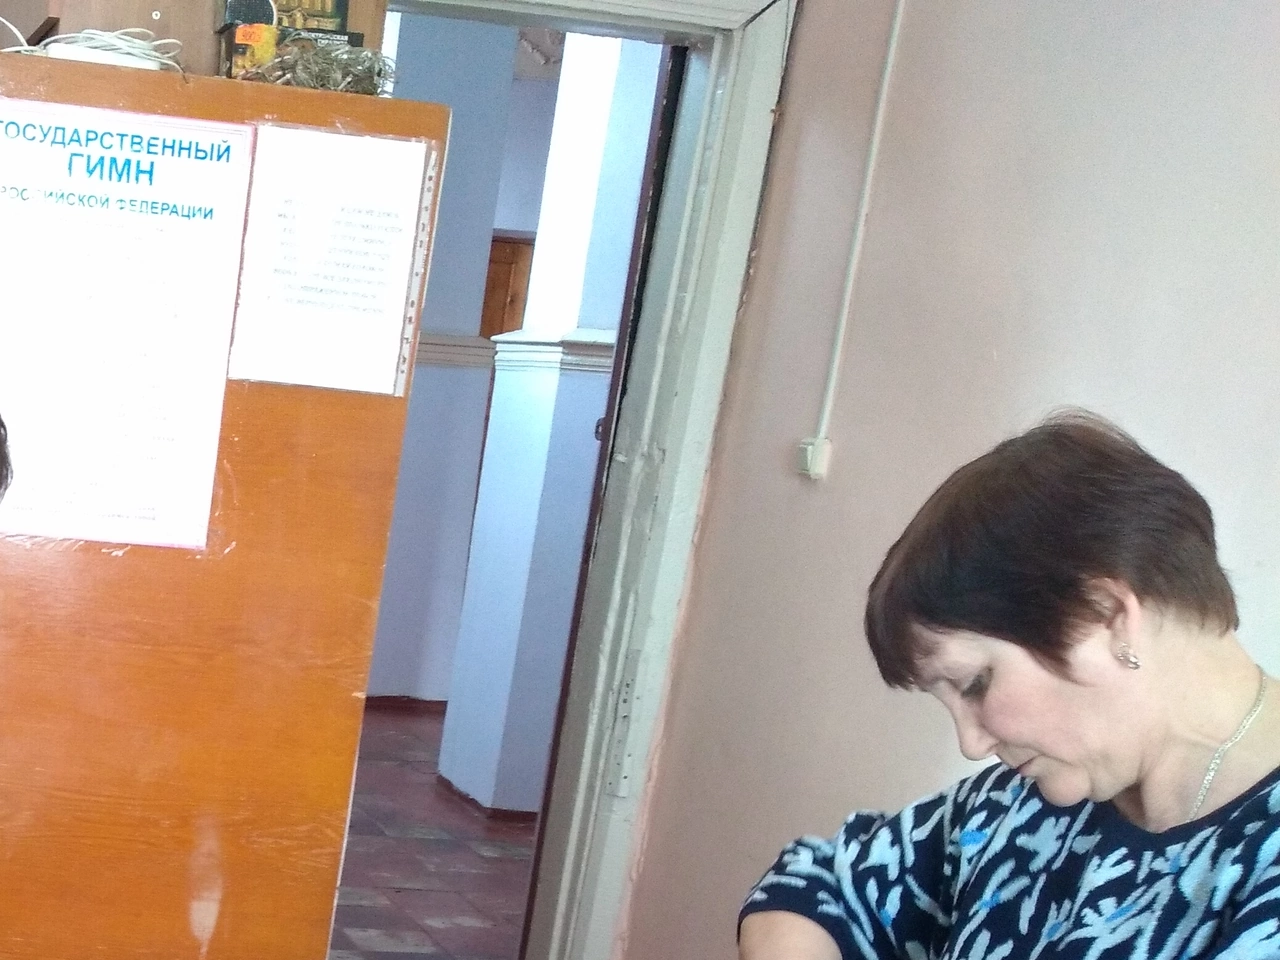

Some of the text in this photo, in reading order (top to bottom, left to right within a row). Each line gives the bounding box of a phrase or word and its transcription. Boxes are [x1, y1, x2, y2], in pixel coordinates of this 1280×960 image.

[67, 152, 155, 186] ГИМН
[0, 186, 214, 220] РОСИЙСКОЙ ФЕДЕРАЦИИ
